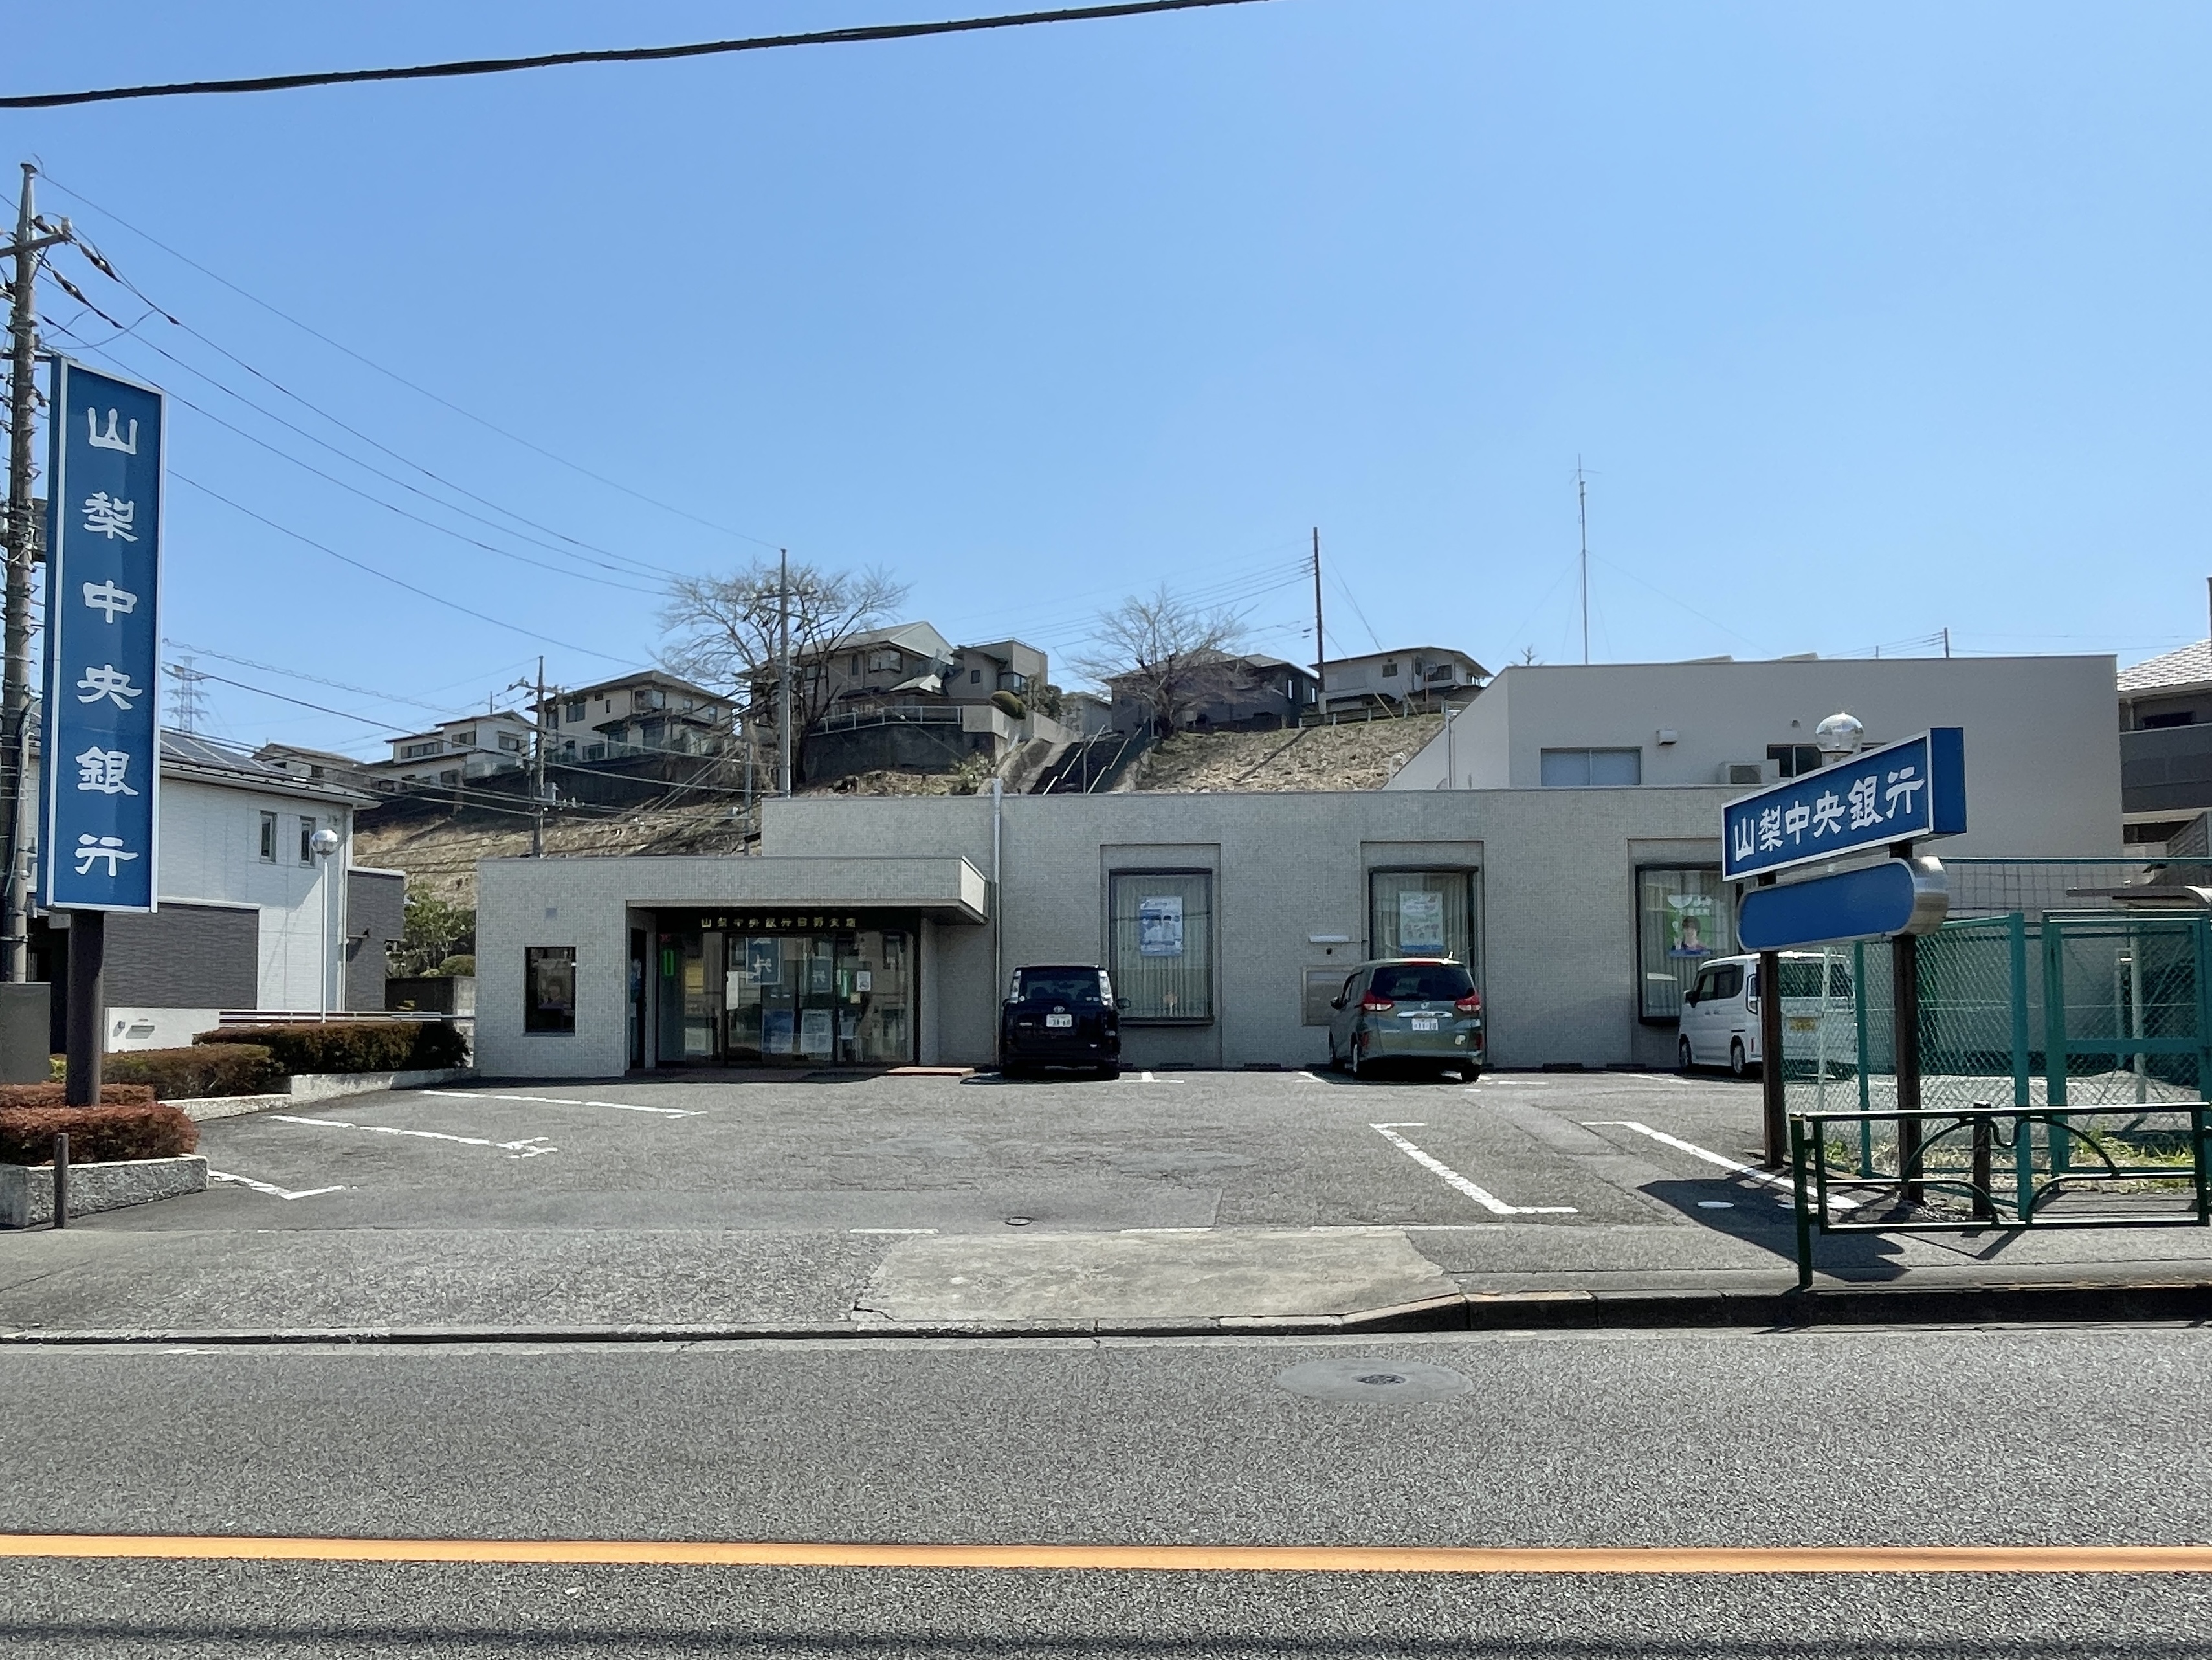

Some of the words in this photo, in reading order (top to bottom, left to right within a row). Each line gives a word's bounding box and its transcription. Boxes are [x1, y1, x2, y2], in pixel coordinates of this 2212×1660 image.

[75, 407, 142, 876] 山梨中央銀行
[1734, 766, 1925, 861] 山梨中央銀行
